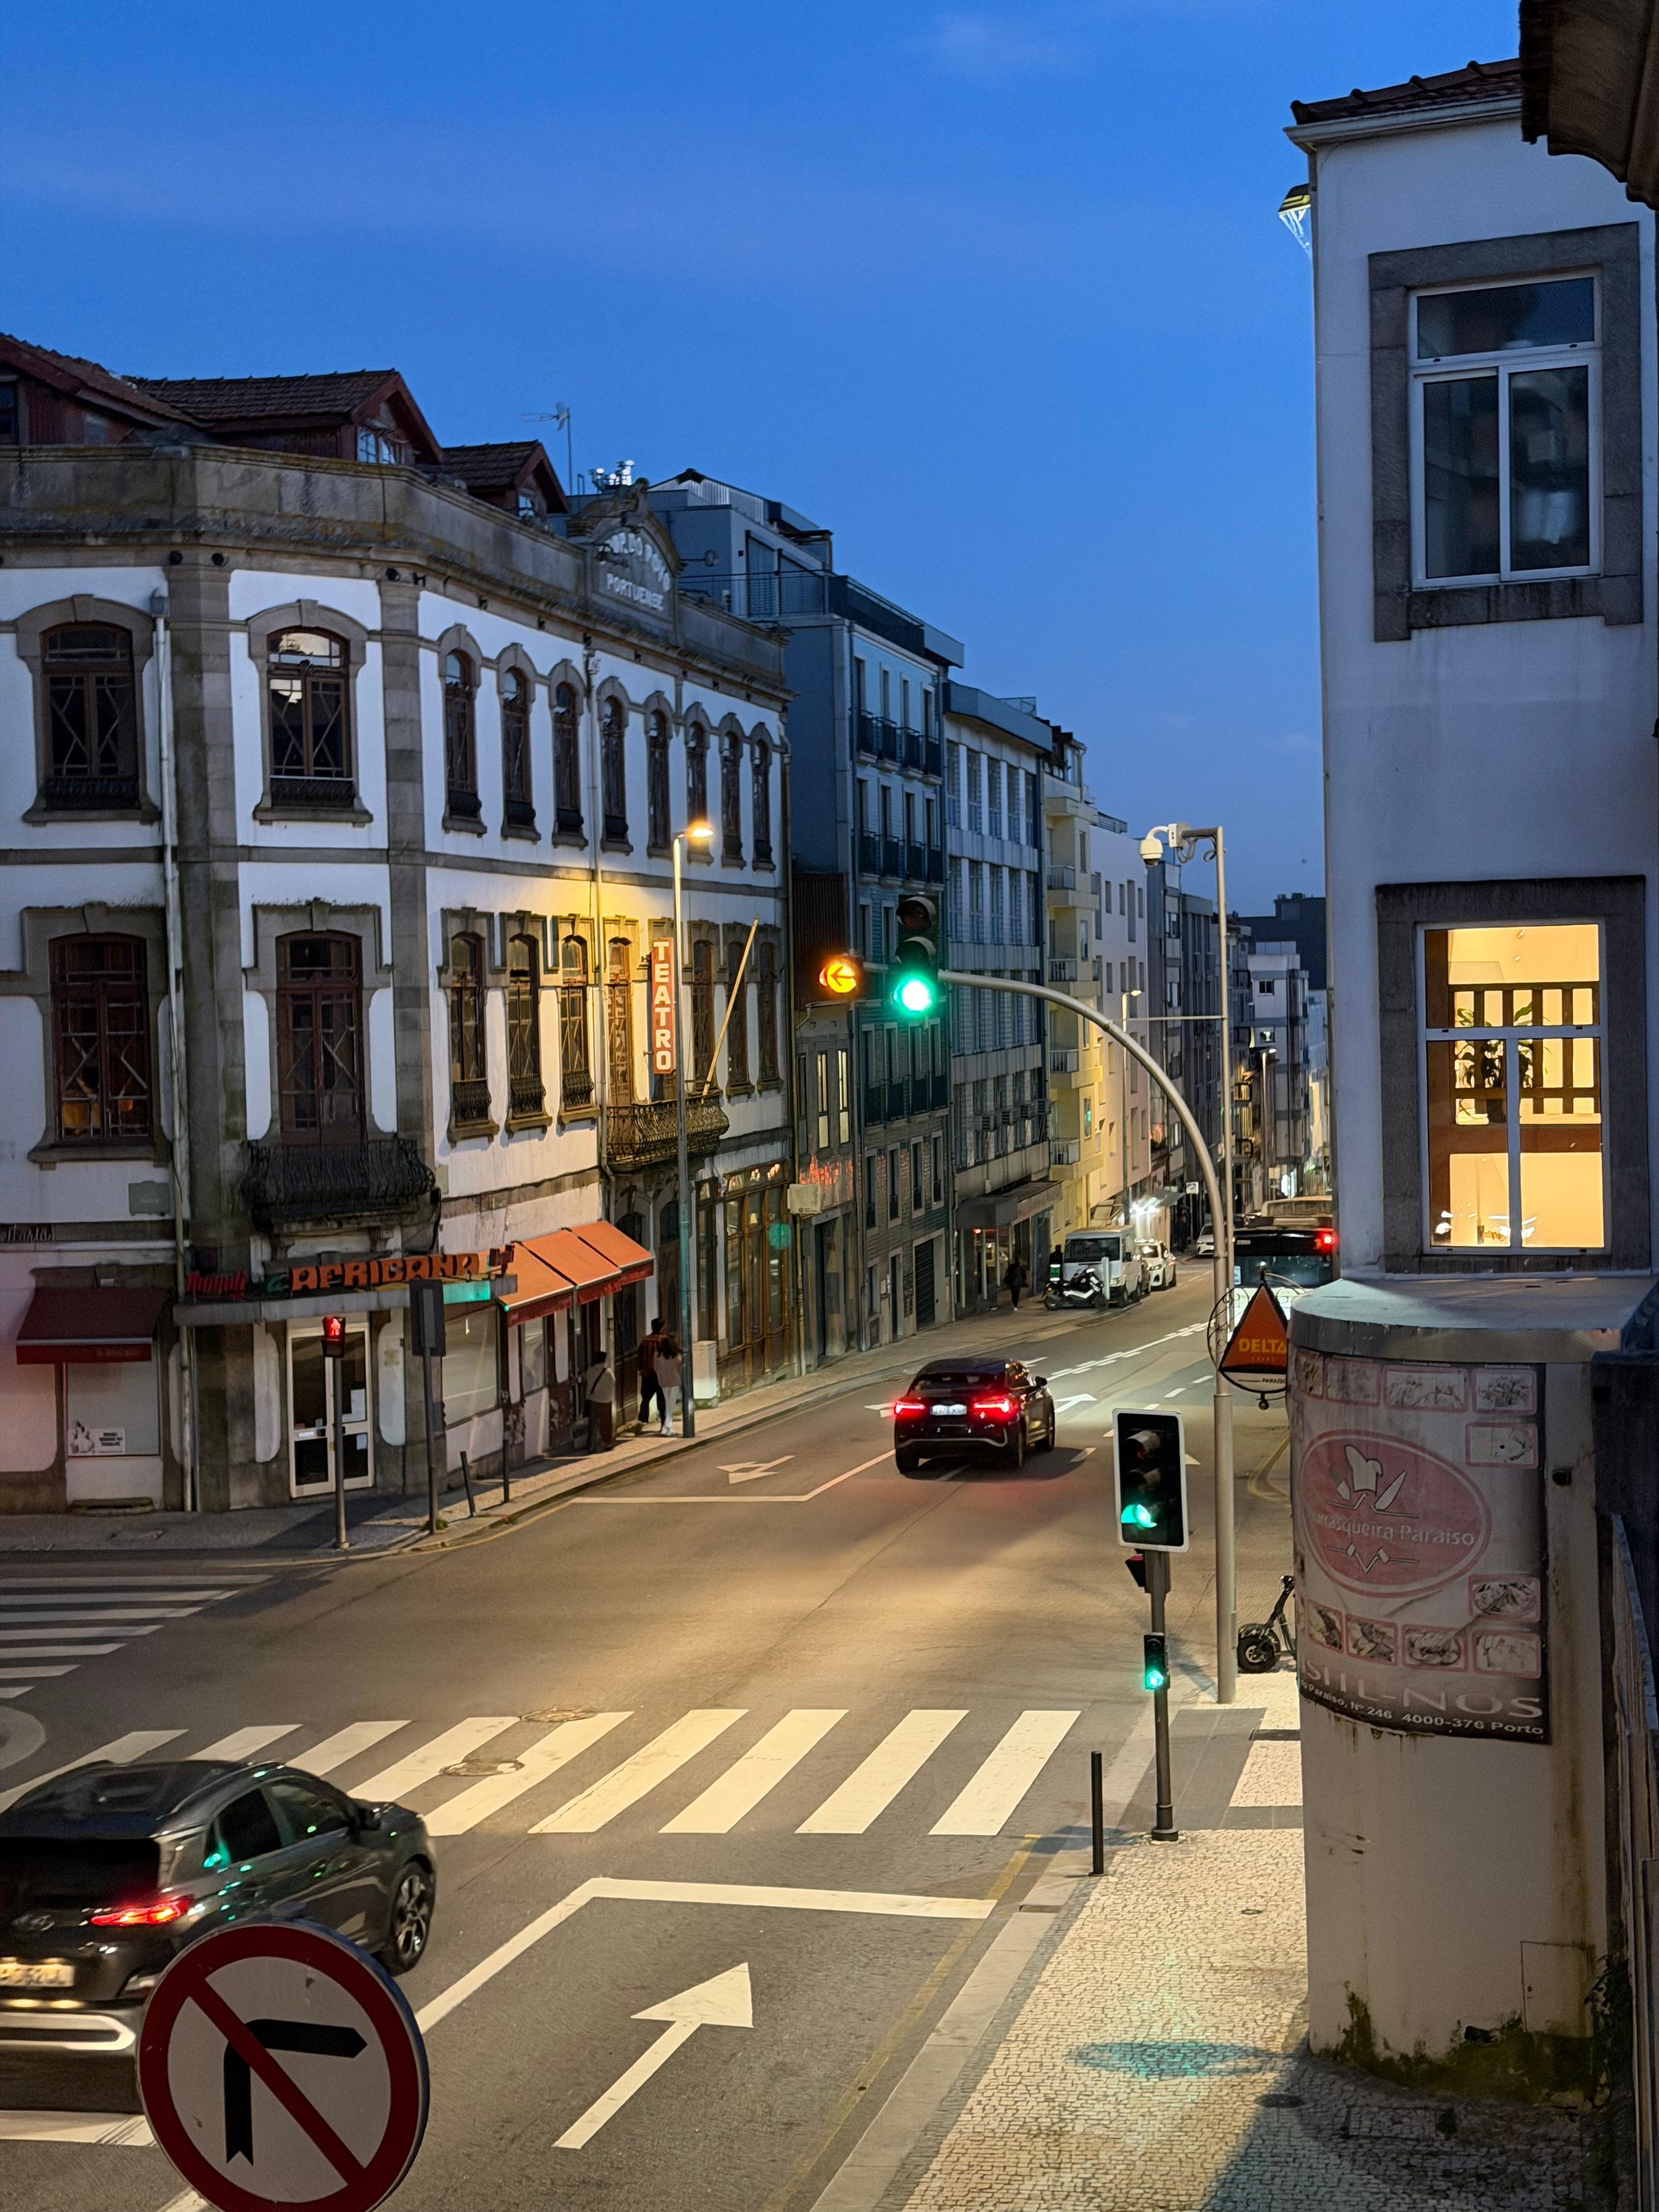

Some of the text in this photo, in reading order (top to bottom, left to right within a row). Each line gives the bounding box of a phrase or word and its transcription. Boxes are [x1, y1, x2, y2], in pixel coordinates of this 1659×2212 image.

[653, 941, 672, 1070] TEATRO
[291, 1252, 479, 1291] AFRICANA
[1239, 1338, 1286, 1354] DELTA
[1400, 1524, 1475, 1545] Paraíso
[1491, 1722, 1543, 1735] Porto
